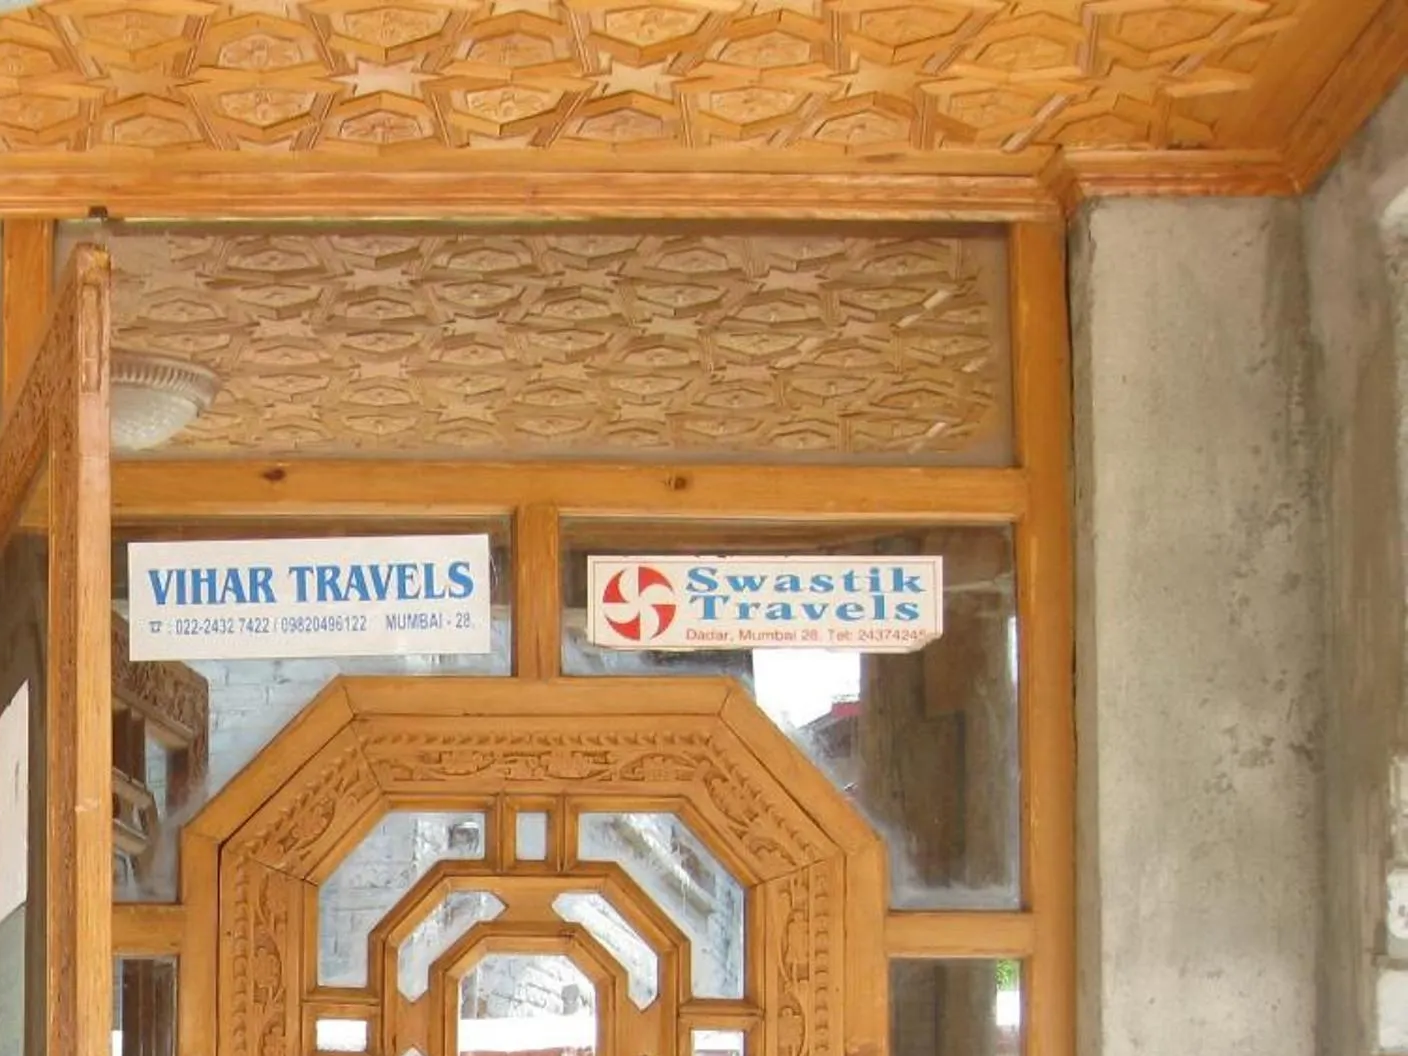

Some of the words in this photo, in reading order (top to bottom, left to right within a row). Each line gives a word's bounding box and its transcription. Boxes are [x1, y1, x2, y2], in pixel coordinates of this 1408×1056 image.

[148, 565, 277, 605] VIHAR
[288, 561, 474, 602] TRAVELS
[685, 566, 927, 594] Swastik
[689, 595, 920, 621] Travels
[239, 616, 270, 634] 7422
[385, 612, 442, 631] MUMBAI
[738, 628, 797, 641] Mumbai
